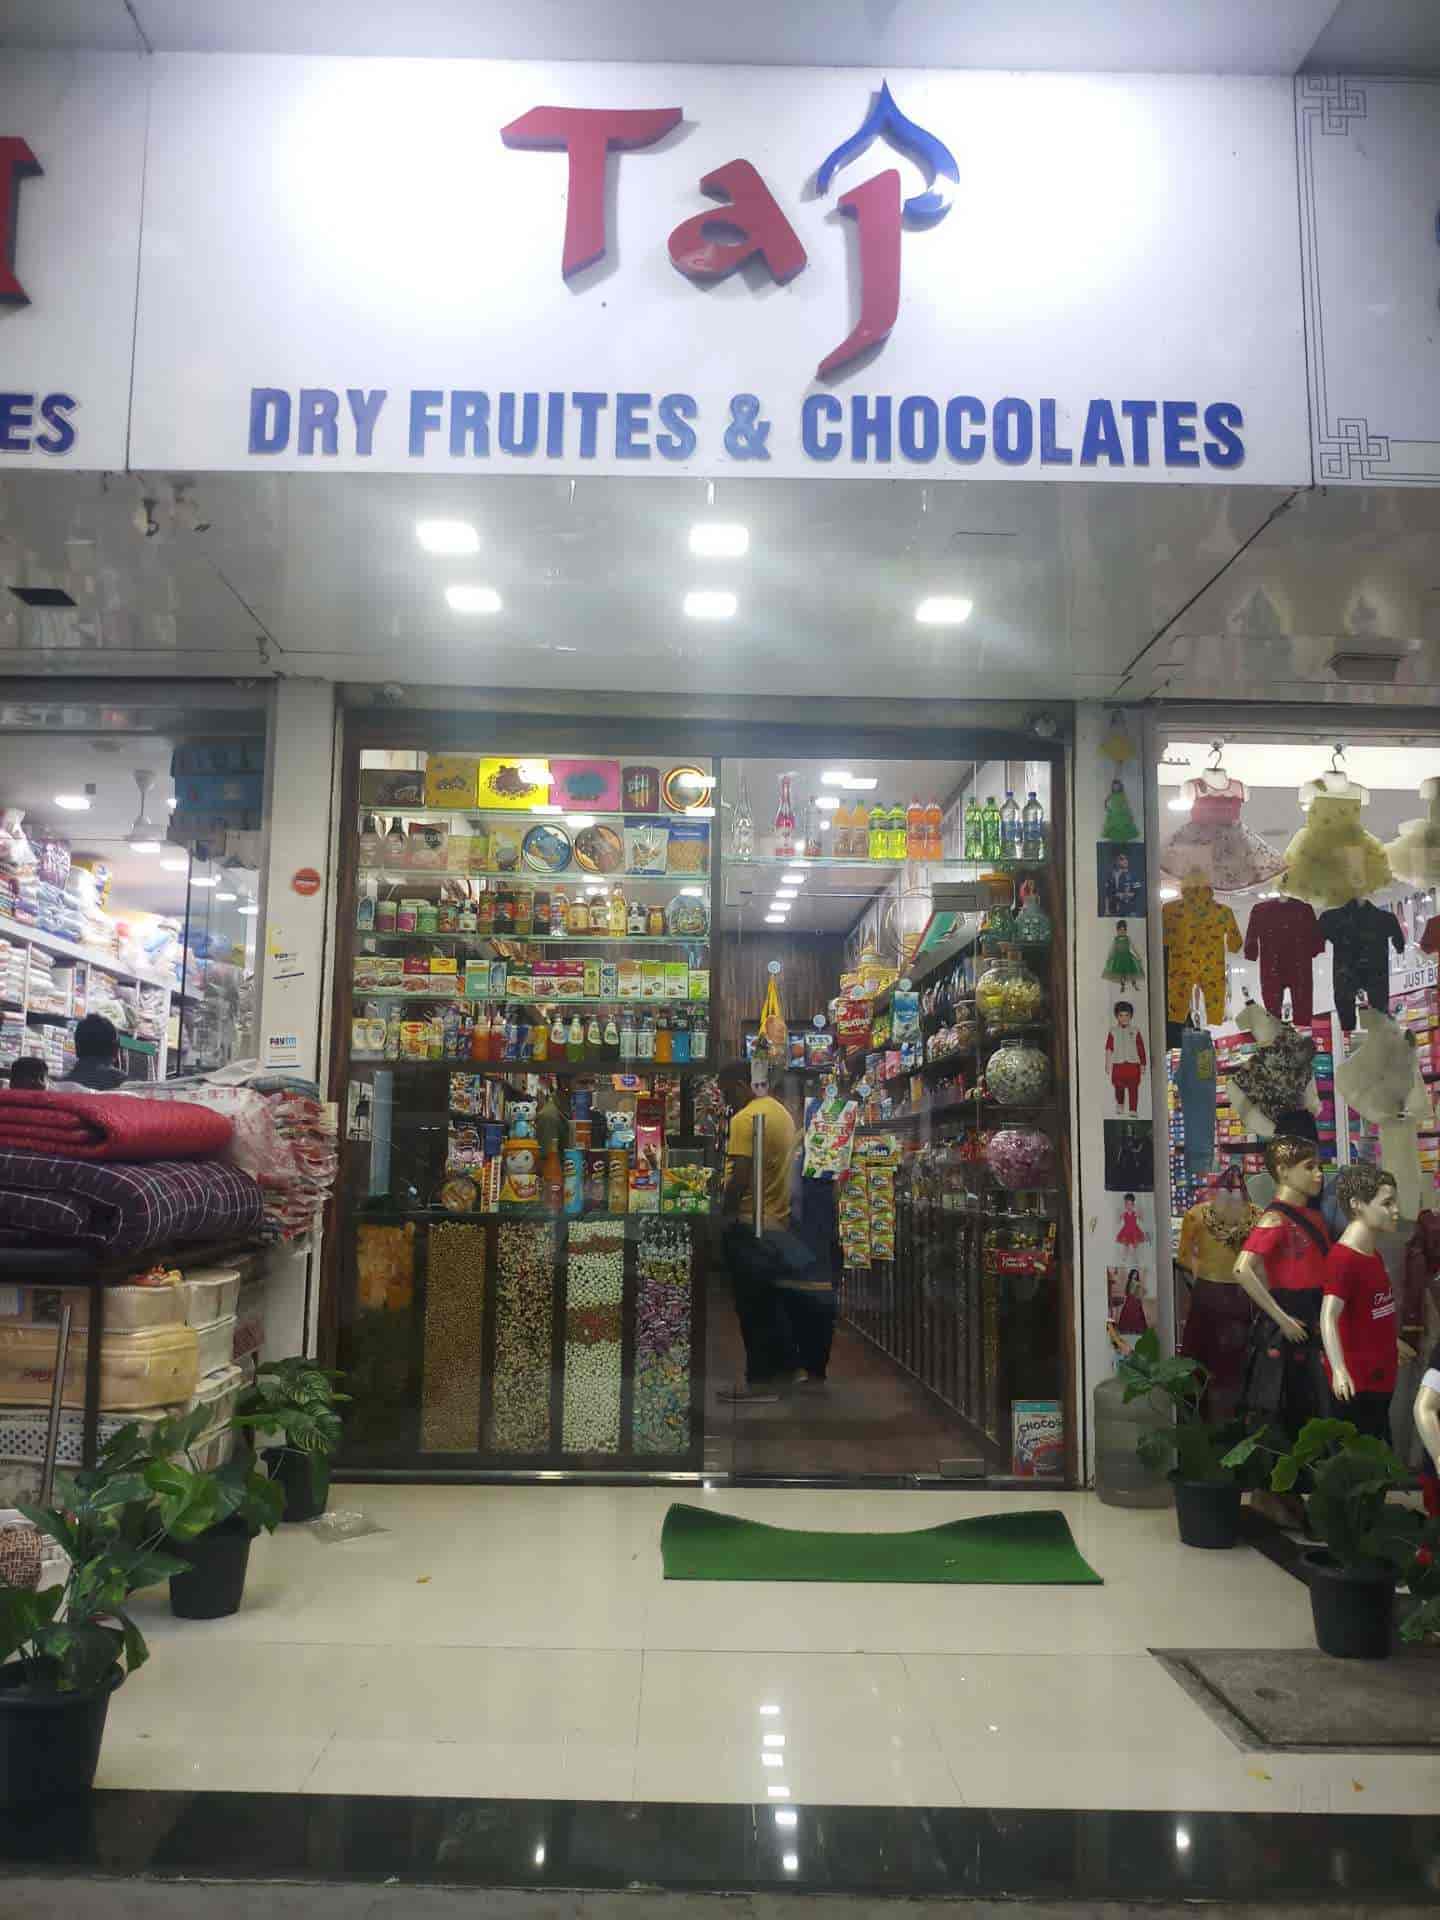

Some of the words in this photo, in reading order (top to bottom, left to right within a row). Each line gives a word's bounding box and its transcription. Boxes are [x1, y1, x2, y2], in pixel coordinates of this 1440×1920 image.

[500, 98, 906, 386] Taj
[248, 387, 387, 457] DRY
[408, 390, 698, 461] FRUITES
[723, 394, 771, 461] &
[801, 394, 1247, 470] CHOCOLATES
[1403, 969, 1425, 989] JUST
